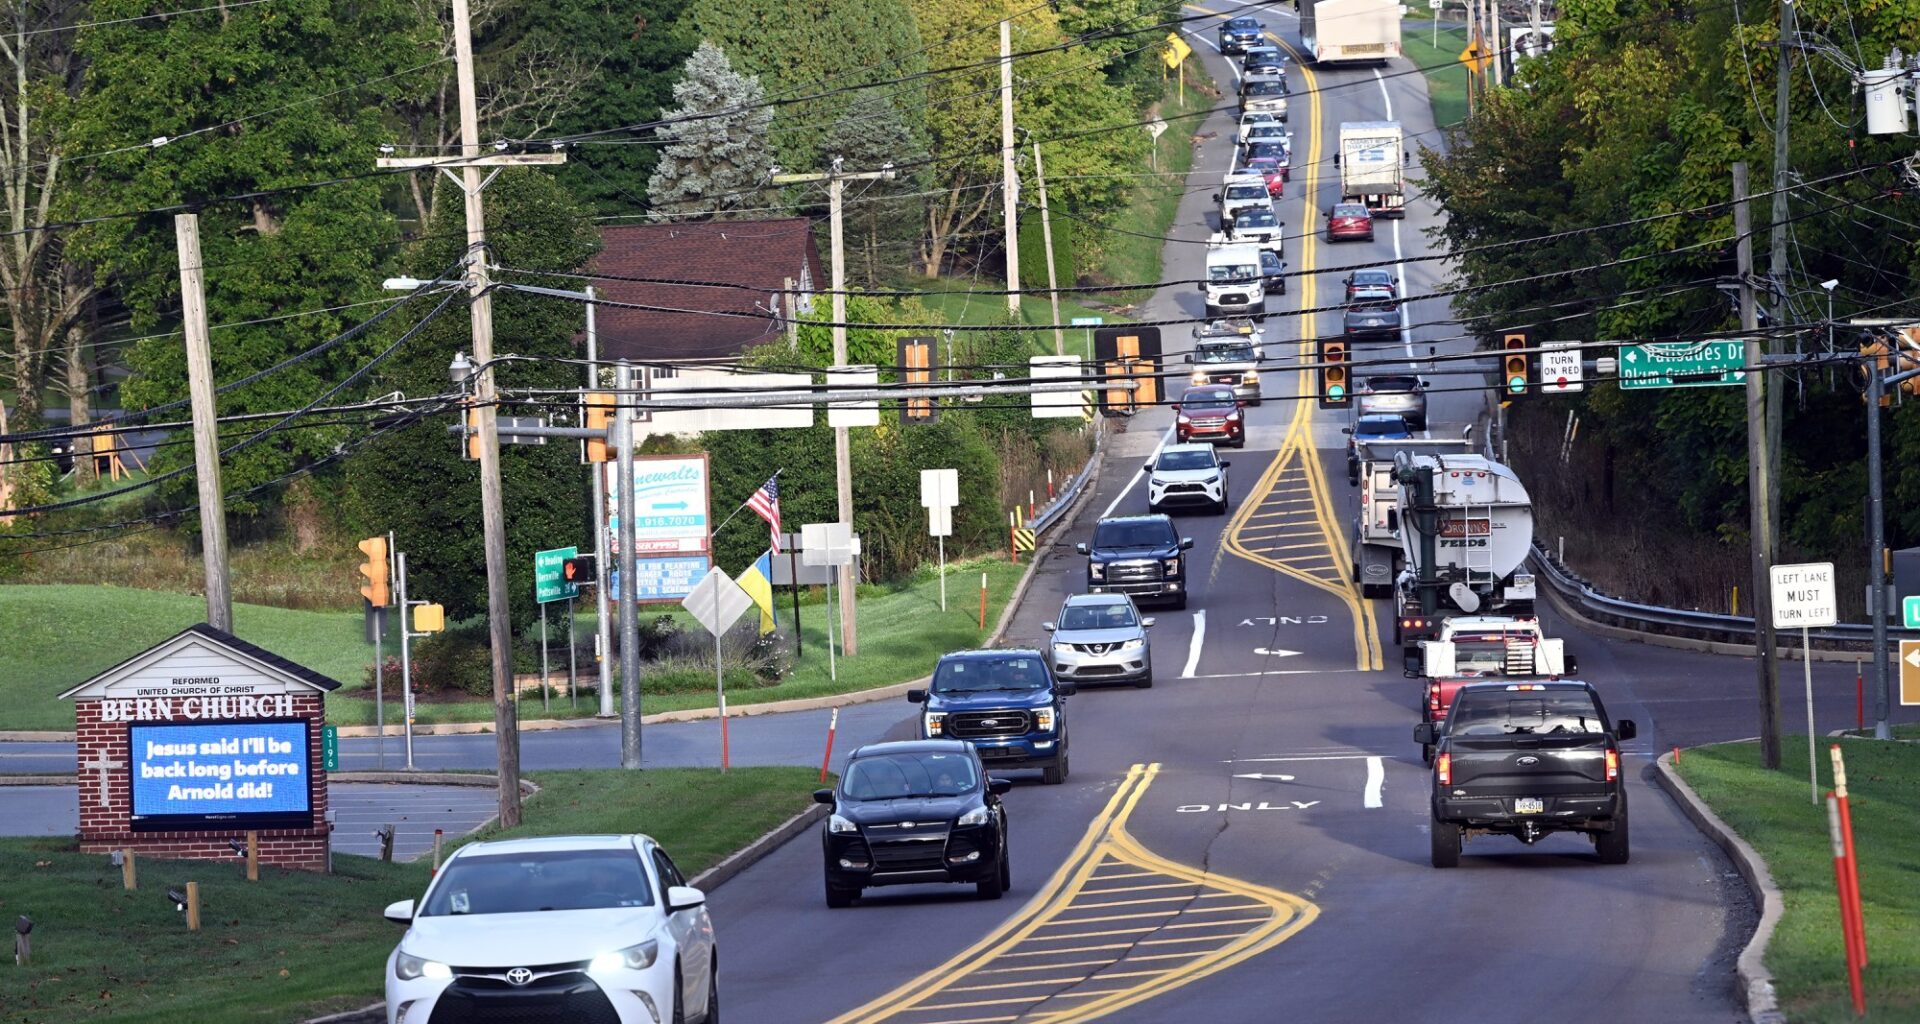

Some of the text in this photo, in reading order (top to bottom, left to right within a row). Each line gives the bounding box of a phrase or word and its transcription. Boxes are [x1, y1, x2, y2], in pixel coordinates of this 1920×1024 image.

[1728, 343, 1744, 360] Dr
[1550, 356, 1574, 365] TURN
[1544, 366, 1579, 375] ON RED
[1625, 367, 1660, 385] Plum
[1440, 538, 1487, 548] FEEDS
[1778, 572, 1829, 584] LEFT LANE
[1787, 589, 1820, 603] MUST
[1779, 607, 1831, 619] TURN LEFT
[172, 677, 220, 686] REFORMED
[137, 685, 255, 696] UNITED CHURCH OF CHRIST
[101, 694, 294, 722] BERN CHURCH
[146, 737, 292, 760] Jesus said I'll be
[327, 729, 335, 768] 3196
[141, 759, 299, 780] back long before
[167, 782, 273, 800] Arnold did!
[1176, 800, 1321, 812] ONLY
